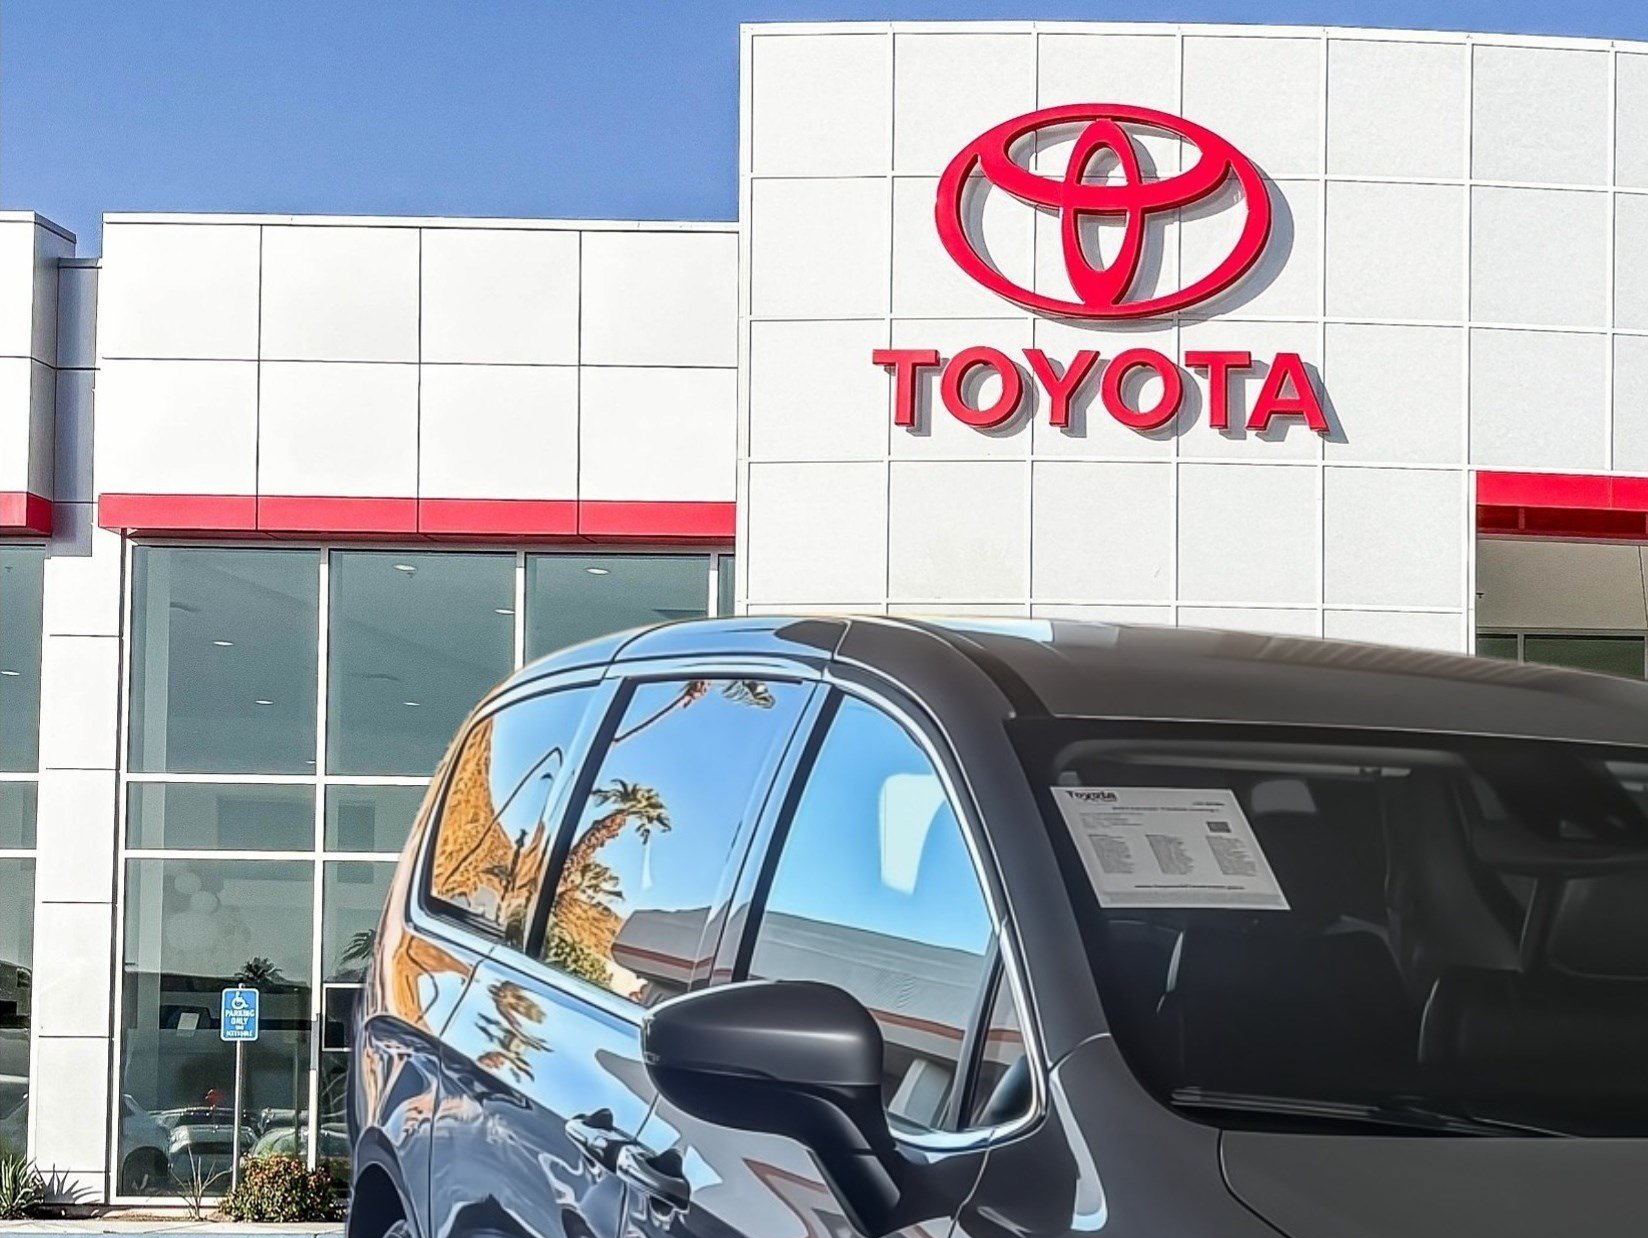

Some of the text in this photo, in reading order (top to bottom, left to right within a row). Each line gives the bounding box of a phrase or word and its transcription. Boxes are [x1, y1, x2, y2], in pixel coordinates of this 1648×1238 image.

[872, 345, 1329, 434] TOYOTA
[225, 1009, 255, 1017] PARKING
[230, 1017, 249, 1025] ONLY
